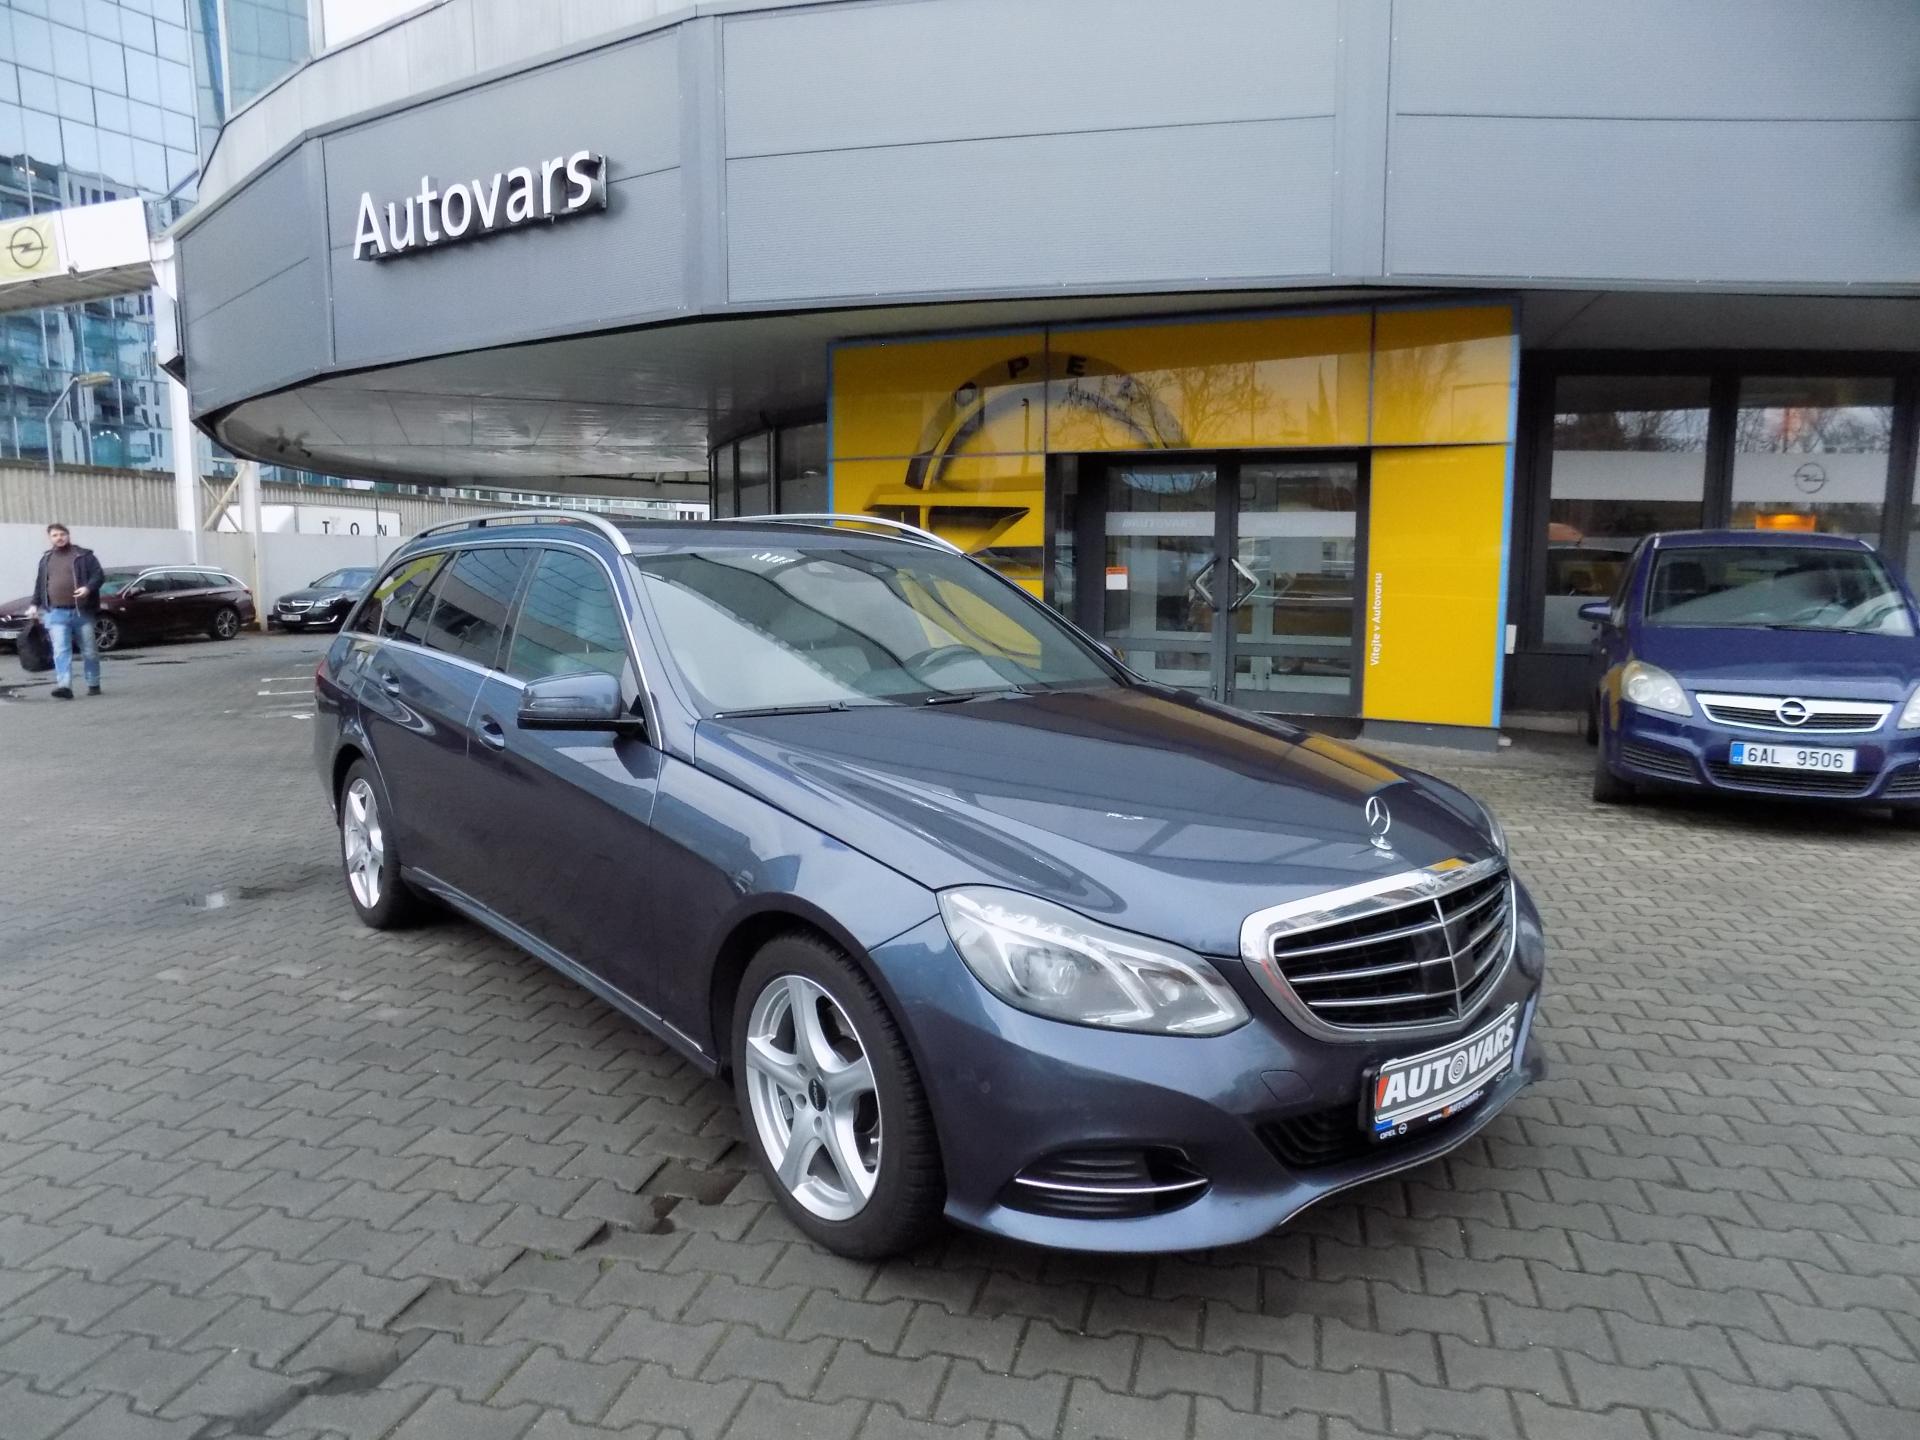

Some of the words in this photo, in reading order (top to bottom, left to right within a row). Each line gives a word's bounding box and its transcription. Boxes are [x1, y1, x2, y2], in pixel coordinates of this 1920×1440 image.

[353, 150, 593, 260] Autovars
[1371, 572, 1382, 623] Autovarsu
[1748, 747, 1780, 764] 6AL
[1796, 751, 1844, 769] 9506
[1381, 1016, 1516, 1108] AUTOVARS
